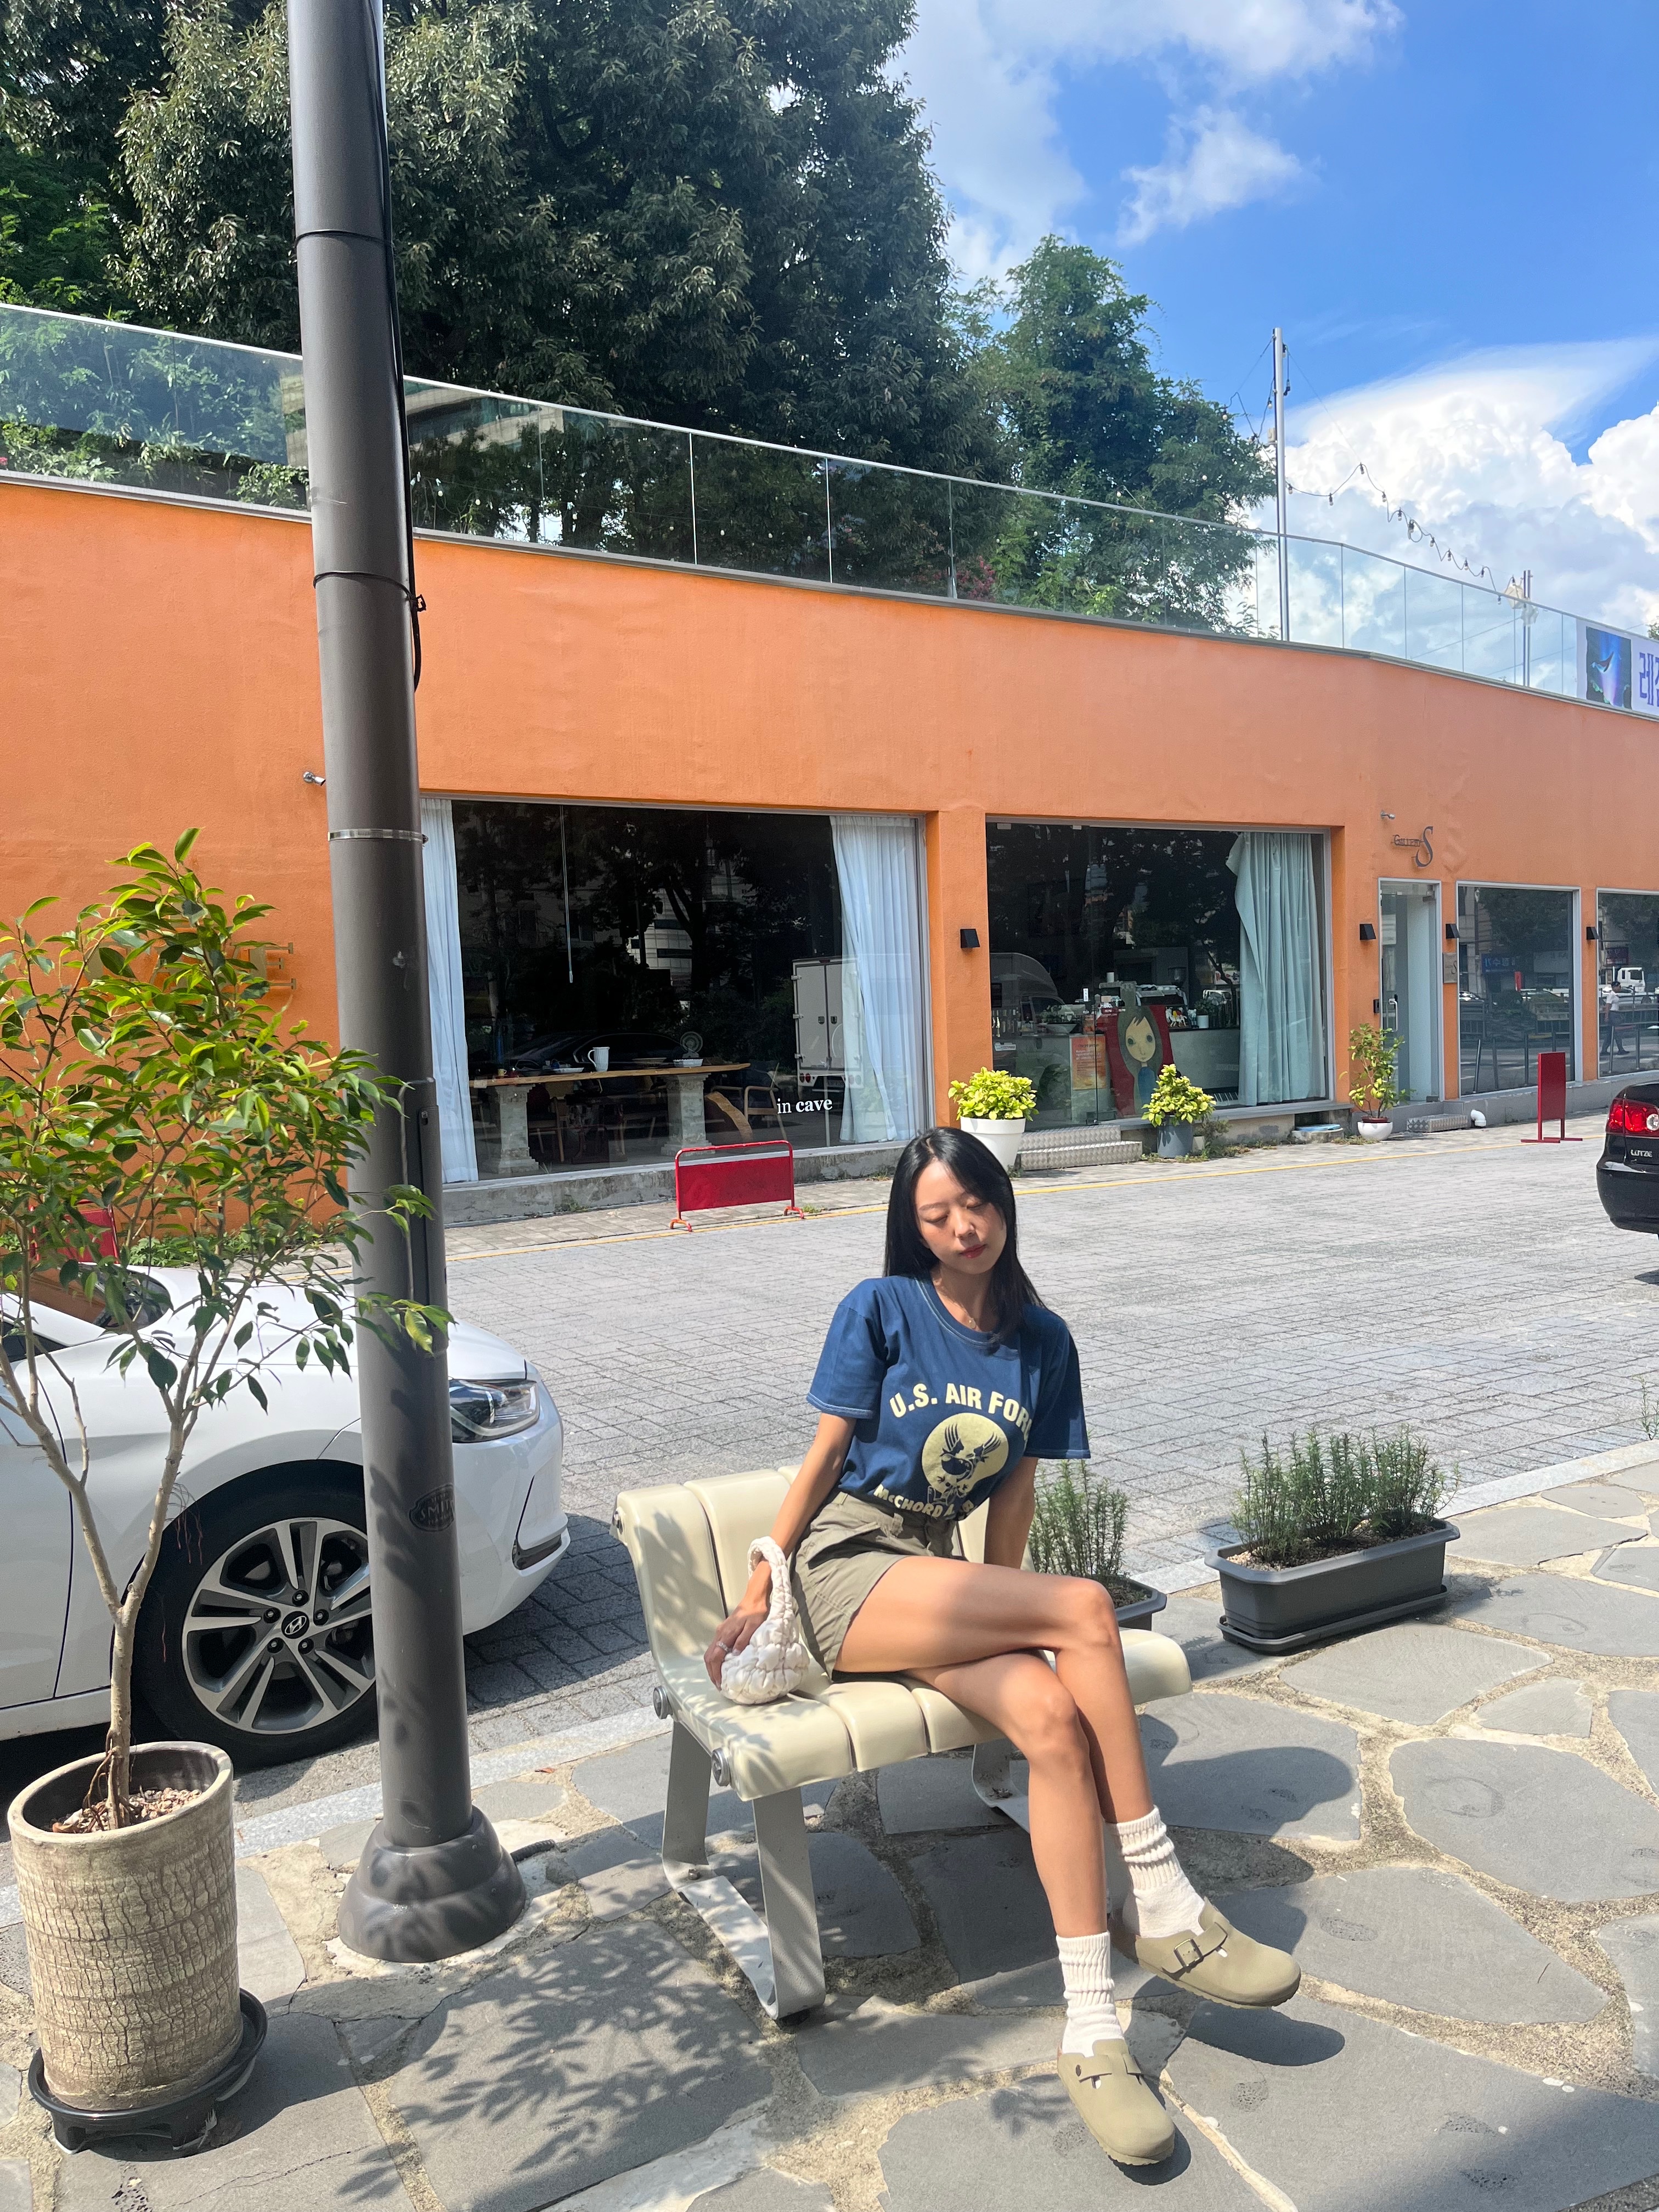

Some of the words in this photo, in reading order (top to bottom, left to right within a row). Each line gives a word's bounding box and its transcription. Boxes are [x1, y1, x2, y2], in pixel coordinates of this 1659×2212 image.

[777, 1098, 792, 1114] in
[795, 1099, 832, 1113] cave
[889, 1383, 938, 1418] U.S.
[945, 1383, 982, 1410] AIR
